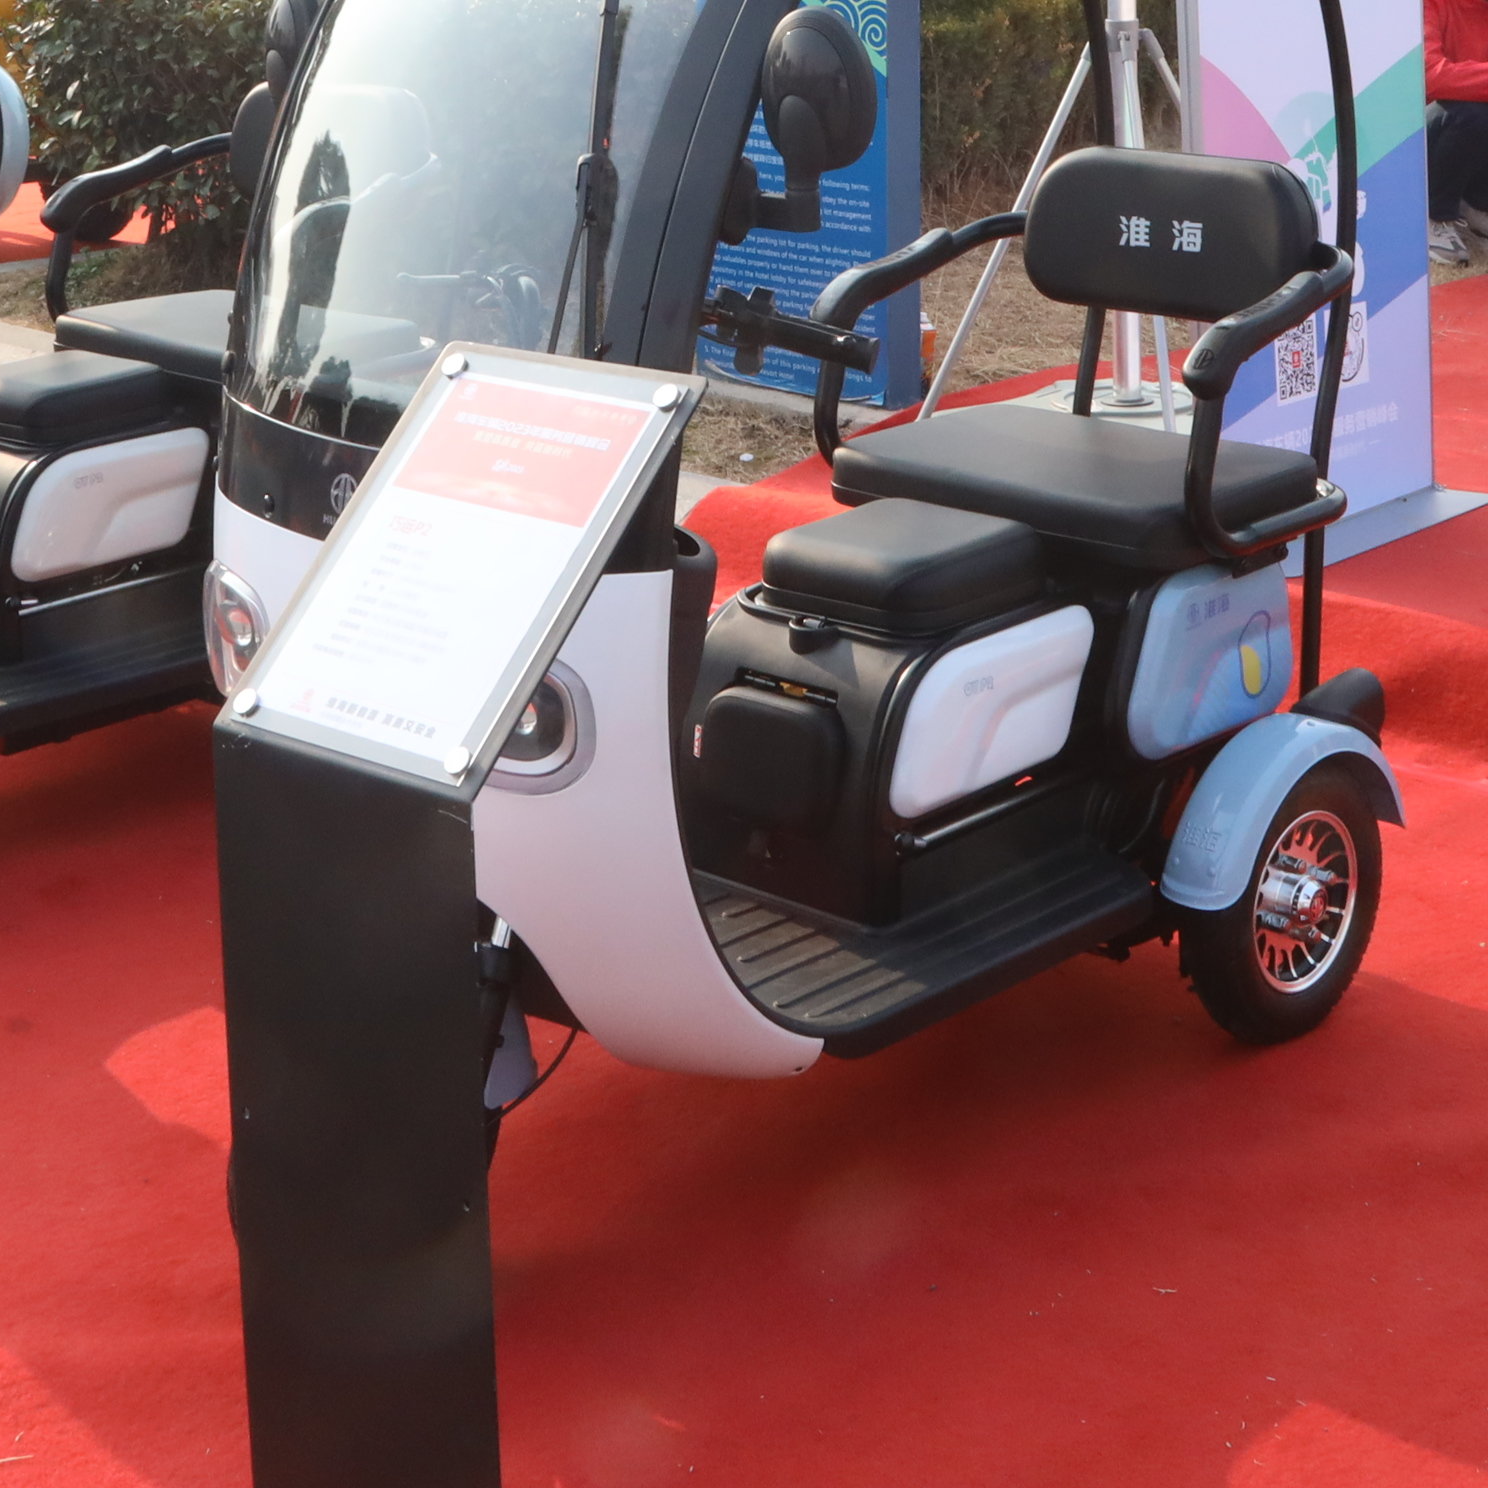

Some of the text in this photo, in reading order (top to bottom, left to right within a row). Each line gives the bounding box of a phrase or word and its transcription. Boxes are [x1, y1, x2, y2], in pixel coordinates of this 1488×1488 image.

[822, 179, 850, 191] following
[833, 210, 872, 220] management
[825, 222, 857, 231] accordance
[1118, 215, 1204, 254] 淮海
[756, 236, 778, 247] parking
[787, 240, 796, 248] for
[850, 249, 871, 258] should
[808, 256, 824, 264] when
[778, 264, 793, 272] hand
[770, 274, 787, 284] lobby
[787, 276, 797, 284] for
[792, 362, 816, 374] parking
